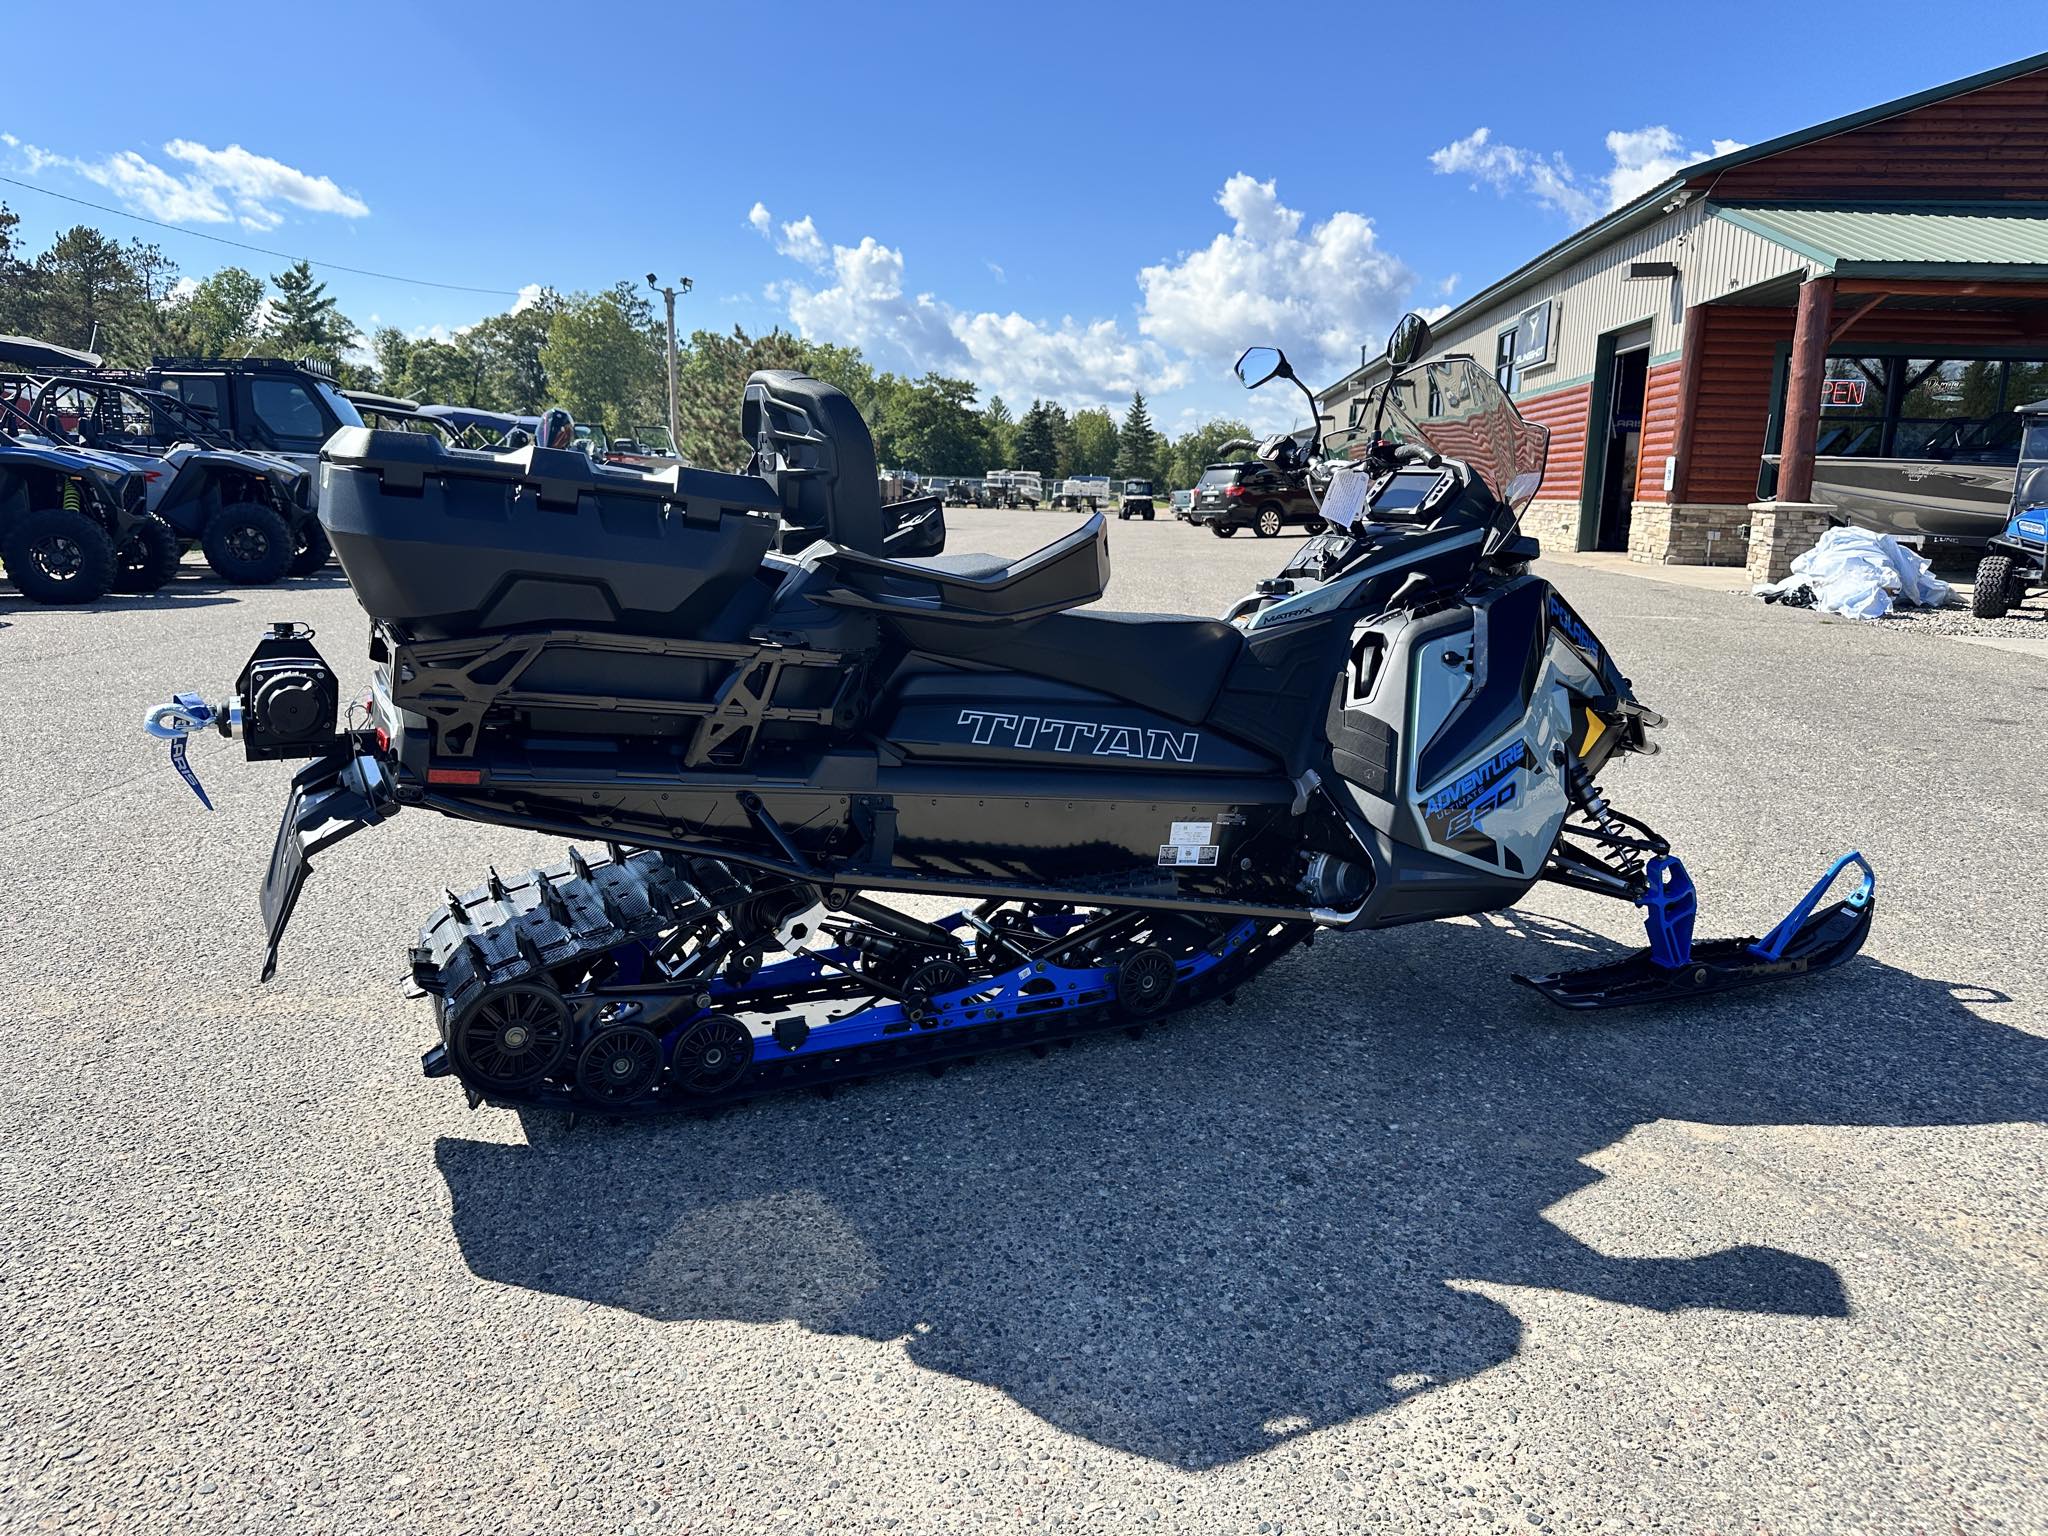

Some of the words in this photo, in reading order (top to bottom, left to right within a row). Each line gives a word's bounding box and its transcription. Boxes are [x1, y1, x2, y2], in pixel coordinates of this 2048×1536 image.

[1821, 381, 1864, 404] PEN
[1263, 606, 1314, 625] MATRYX
[1550, 596, 1599, 662] POLARIS
[957, 709, 1200, 763] TITAN
[1424, 738, 1526, 820] ADVENTURE
[1436, 786, 1487, 821] ULTIMATE
[1446, 780, 1518, 841] 850
